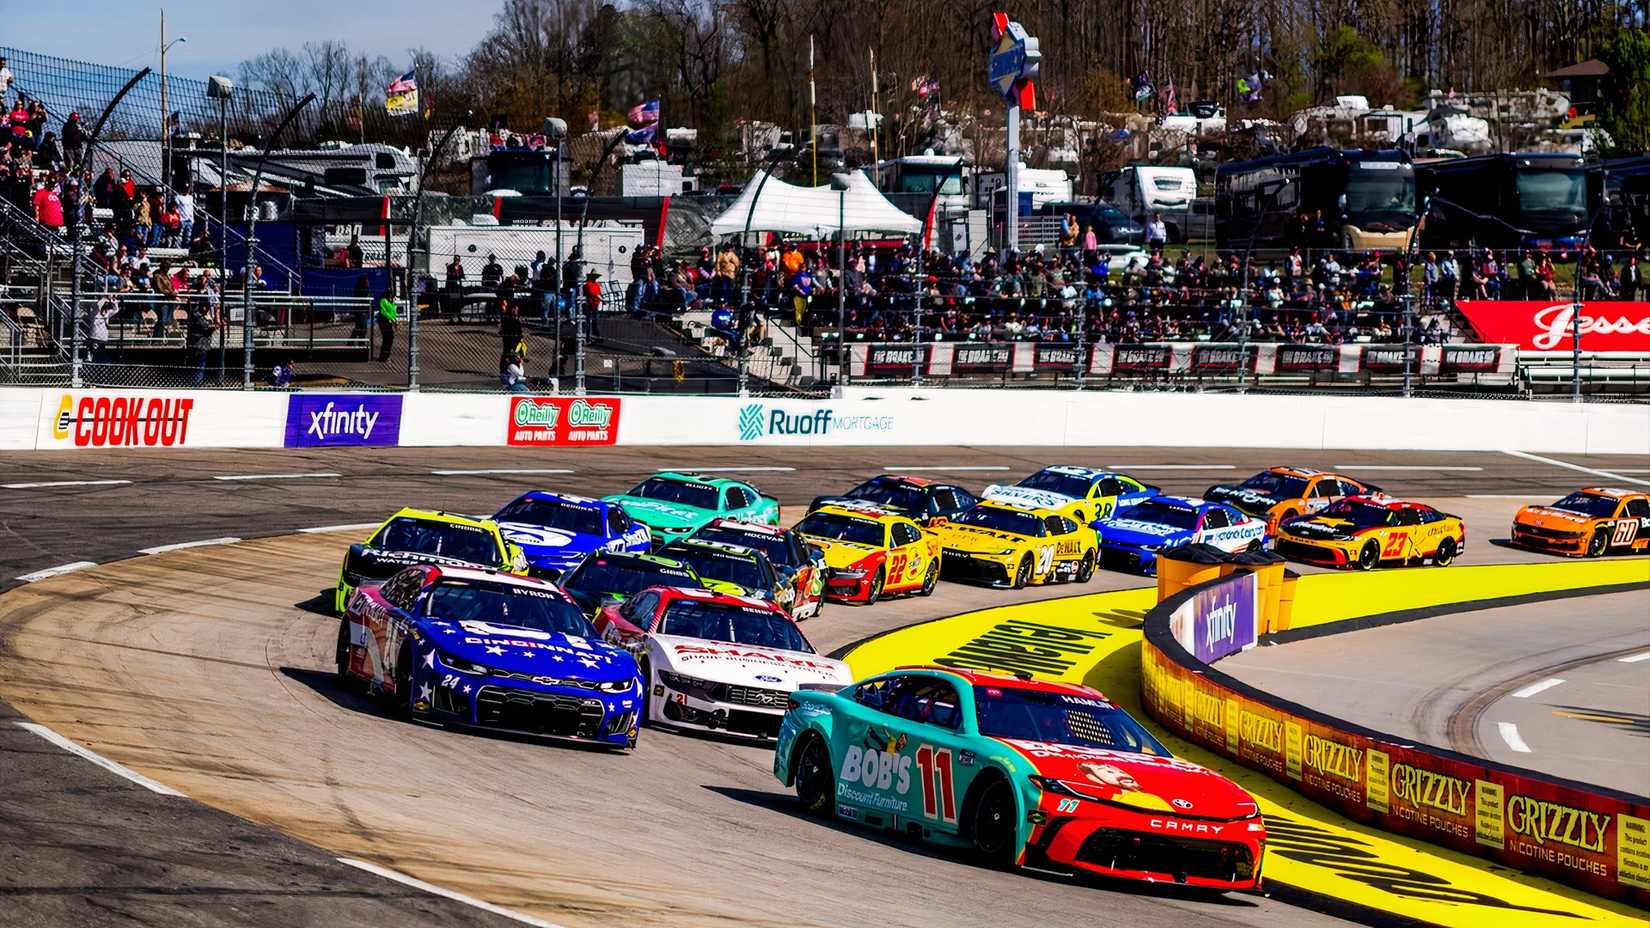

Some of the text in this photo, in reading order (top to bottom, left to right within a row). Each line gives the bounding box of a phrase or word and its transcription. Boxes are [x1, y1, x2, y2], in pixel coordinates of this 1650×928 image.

[307, 401, 380, 440] xfinity
[514, 430, 608, 441] AUTO PARTS AUTO PARTS
[769, 409, 894, 435] Ruoff MORTGAGE
[744, 532, 784, 543] HOCEVAR
[1382, 532, 1408, 557] 23
[886, 554, 907, 585] 22
[1035, 544, 1055, 576] 20
[513, 588, 555, 600] BYRON
[1206, 593, 1237, 654] xfinity
[441, 674, 461, 689] 24
[676, 693, 688, 705] 21
[1062, 694, 1114, 710] HAMLIN
[840, 745, 912, 794] BOB'S
[1303, 734, 1363, 783] GRIZZLY
[838, 782, 873, 807] Discount
[873, 791, 908, 812] Furniture
[916, 743, 959, 826] 11
[1392, 762, 1472, 817] GRIZZLY
[1057, 799, 1081, 813] 11
[1150, 819, 1225, 835] CAMRY
[1392, 805, 1469, 838] NICOTINE POUCHES
[1507, 794, 1611, 853] GRIZZLY
[1510, 840, 1556, 863] NICOTINE
[1557, 852, 1608, 877] POUCHES
